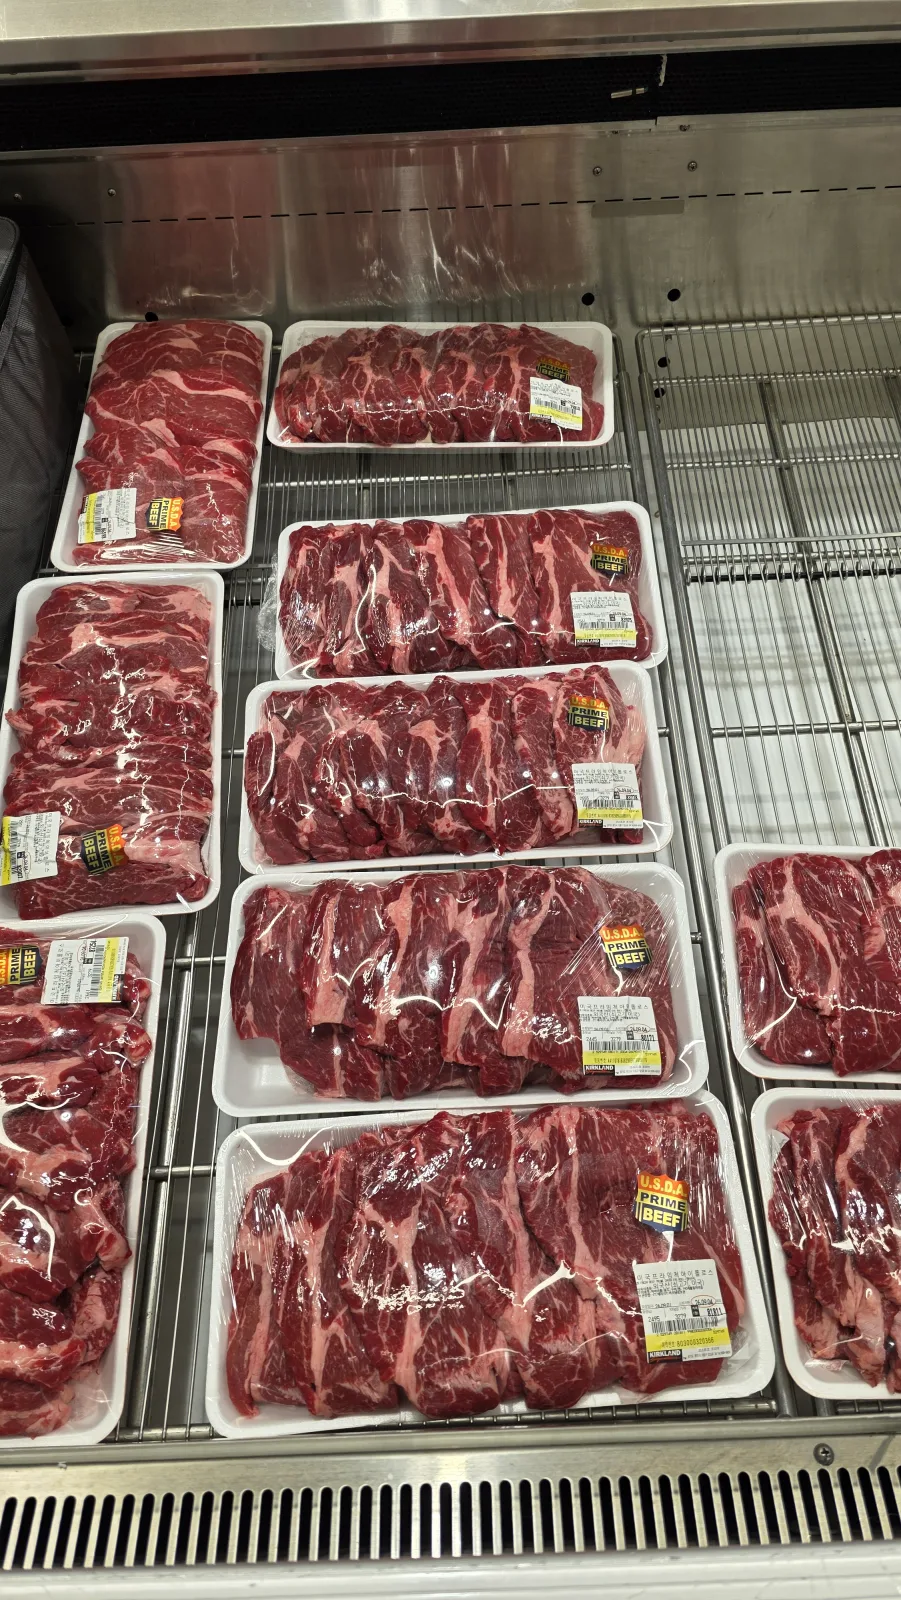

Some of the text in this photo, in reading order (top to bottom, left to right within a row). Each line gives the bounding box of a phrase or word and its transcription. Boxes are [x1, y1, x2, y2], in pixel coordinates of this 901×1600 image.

[542, 369, 566, 379] BEEF
[149, 502, 159, 526] BEEF
[160, 500, 169, 530] PRIME
[593, 545, 628, 557] U.S.D.A.
[594, 554, 628, 564] PRIME
[597, 562, 624, 572] BEEF
[571, 696, 608, 710] U.S.D.A.
[571, 706, 608, 719] PRIME
[574, 716, 605, 728] BEEF
[97, 832, 112, 869] PRIME
[107, 826, 123, 865] U.S.D.A.
[84, 839, 99, 869] BEEF
[602, 927, 643, 940] U.S.D.A.
[608, 940, 647, 951] PRIME
[10, 948, 20, 982] PRIME
[24, 949, 36, 977] BEEF
[615, 952, 645, 965] BEEF
[640, 1174, 688, 1197] U.S.D.A.
[640, 1191, 686, 1212] PRIME
[643, 1207, 681, 1228] BEEF
[706, 1307, 723, 1317] 81811
[649, 1350, 681, 1358] KIRKLAND
